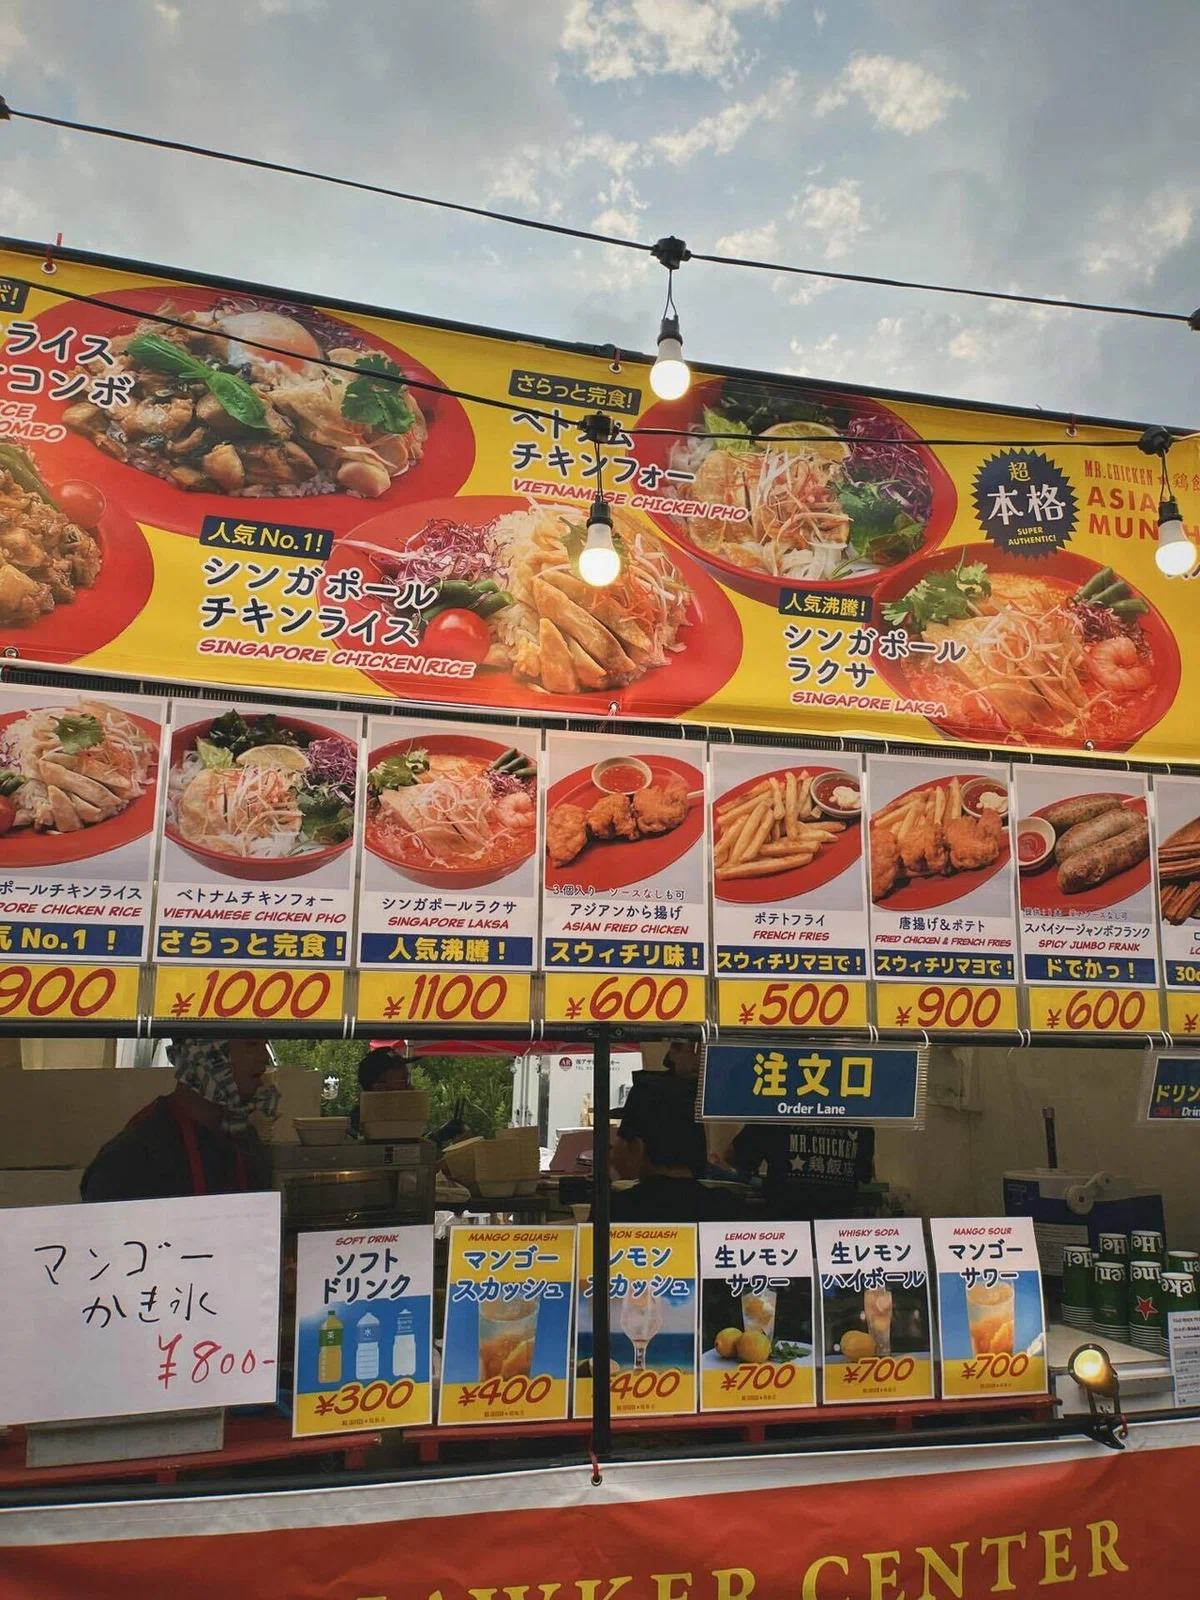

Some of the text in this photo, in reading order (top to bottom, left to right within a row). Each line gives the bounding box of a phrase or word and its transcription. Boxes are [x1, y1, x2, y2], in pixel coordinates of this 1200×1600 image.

[0, 364, 133, 407] コンボ
[517, 375, 633, 409] さらっと完食!
[512, 408, 633, 449] ベトム
[512, 443, 695, 489] チキンフォー
[1008, 461, 1031, 482] 超
[512, 479, 748, 521] VIETNAMESE CHICKEN PHO
[987, 483, 1066, 526] 本格
[1087, 486, 1158, 513] ASIA
[1008, 535, 1057, 546] AUTHENTIC!
[1017, 526, 1043, 535] SUPER
[203, 557, 437, 608] シンガポール
[785, 592, 866, 618] 人気沸騰!
[201, 596, 418, 646] チキンライス
[784, 625, 966, 661] シンガポール
[200, 639, 475, 677] SINGAPORE CHICKEN RICE
[788, 656, 875, 688] ラクサ
[792, 692, 947, 716] SINGAPORE LAKSA
[0, 880, 142, 900] ポールチキンライス
[177, 888, 334, 907] ベトナムチキンフォー
[553, 884, 685, 900] 3個入り ソースなしも可
[41, 904, 105, 916] CHICKEN
[108, 907, 142, 917] RICE
[163, 908, 346, 924] VIETNAMESE CHICKEN PHO
[382, 897, 517, 914] シンガポールラクサ
[570, 902, 683, 920] アジアンから揚げ
[388, 916, 509, 929] SINGAPORE LAKSA
[562, 922, 689, 935] ASIAN FRIED CHICKEN
[754, 912, 826, 926] ポテトフライ
[899, 916, 985, 932] 唐揚げ&ポテト
[1024, 923, 1150, 939] スパイシージャンボフランク
[160, 930, 344, 958] さらっと完食！
[753, 930, 830, 941] FRENCH FRIES
[875, 934, 1012, 947] FRIED CHICKEN & FRENCH FRIES
[1038, 940, 1140, 951] SPICY JUMBO FRANK
[388, 937, 506, 962] 人気沸騰！
[551, 941, 699, 967] スウィチリ味！
[717, 952, 861, 972] スウィチリマヨで！
[876, 955, 1013, 976] スウィチリマヨで！
[1047, 958, 1135, 979] ドでかっ！
[171, 969, 331, 1018] ¥1000
[383, 974, 507, 1020] ¥1100
[565, 976, 688, 1020] ¥600
[739, 983, 849, 1026] ¥500
[896, 986, 1002, 1028] ¥900
[1046, 990, 1145, 1030] ¥600
[752, 1052, 873, 1098] 注文口
[777, 1102, 846, 1115] Order Lane
[336, 1234, 399, 1246] SOFT DRINK
[468, 1233, 558, 1242] MANGO SQUASH
[609, 1231, 678, 1239] MON SQUASH
[725, 1232, 785, 1241] LEMON SOUR
[838, 1228, 900, 1237] WHISKY SODA
[988, 1227, 1012, 1235] SOUR
[336, 1248, 398, 1275] ソフト
[464, 1245, 559, 1270] マンゴー
[715, 1244, 798, 1268] 生レモン
[831, 1241, 911, 1264] 生レモン
[948, 1238, 1023, 1260] マンゴー
[34, 1241, 214, 1285] マンゴー
[323, 1274, 411, 1304] ドリンク
[453, 1276, 563, 1301] スカッシュ
[727, 1273, 789, 1296] サワー
[823, 1267, 925, 1291] ハイボール
[961, 1267, 1017, 1288] サワー
[82, 1283, 217, 1328] かき氷
[721, 1364, 796, 1391] ¥700
[843, 1357, 914, 1383] ¥700
[961, 1353, 1029, 1379] ¥700
[314, 1380, 414, 1416] ¥300
[458, 1376, 551, 1406] ¥400
[609, 1371, 680, 1400] 400
[802, 1520, 1129, 1600] CENTER
